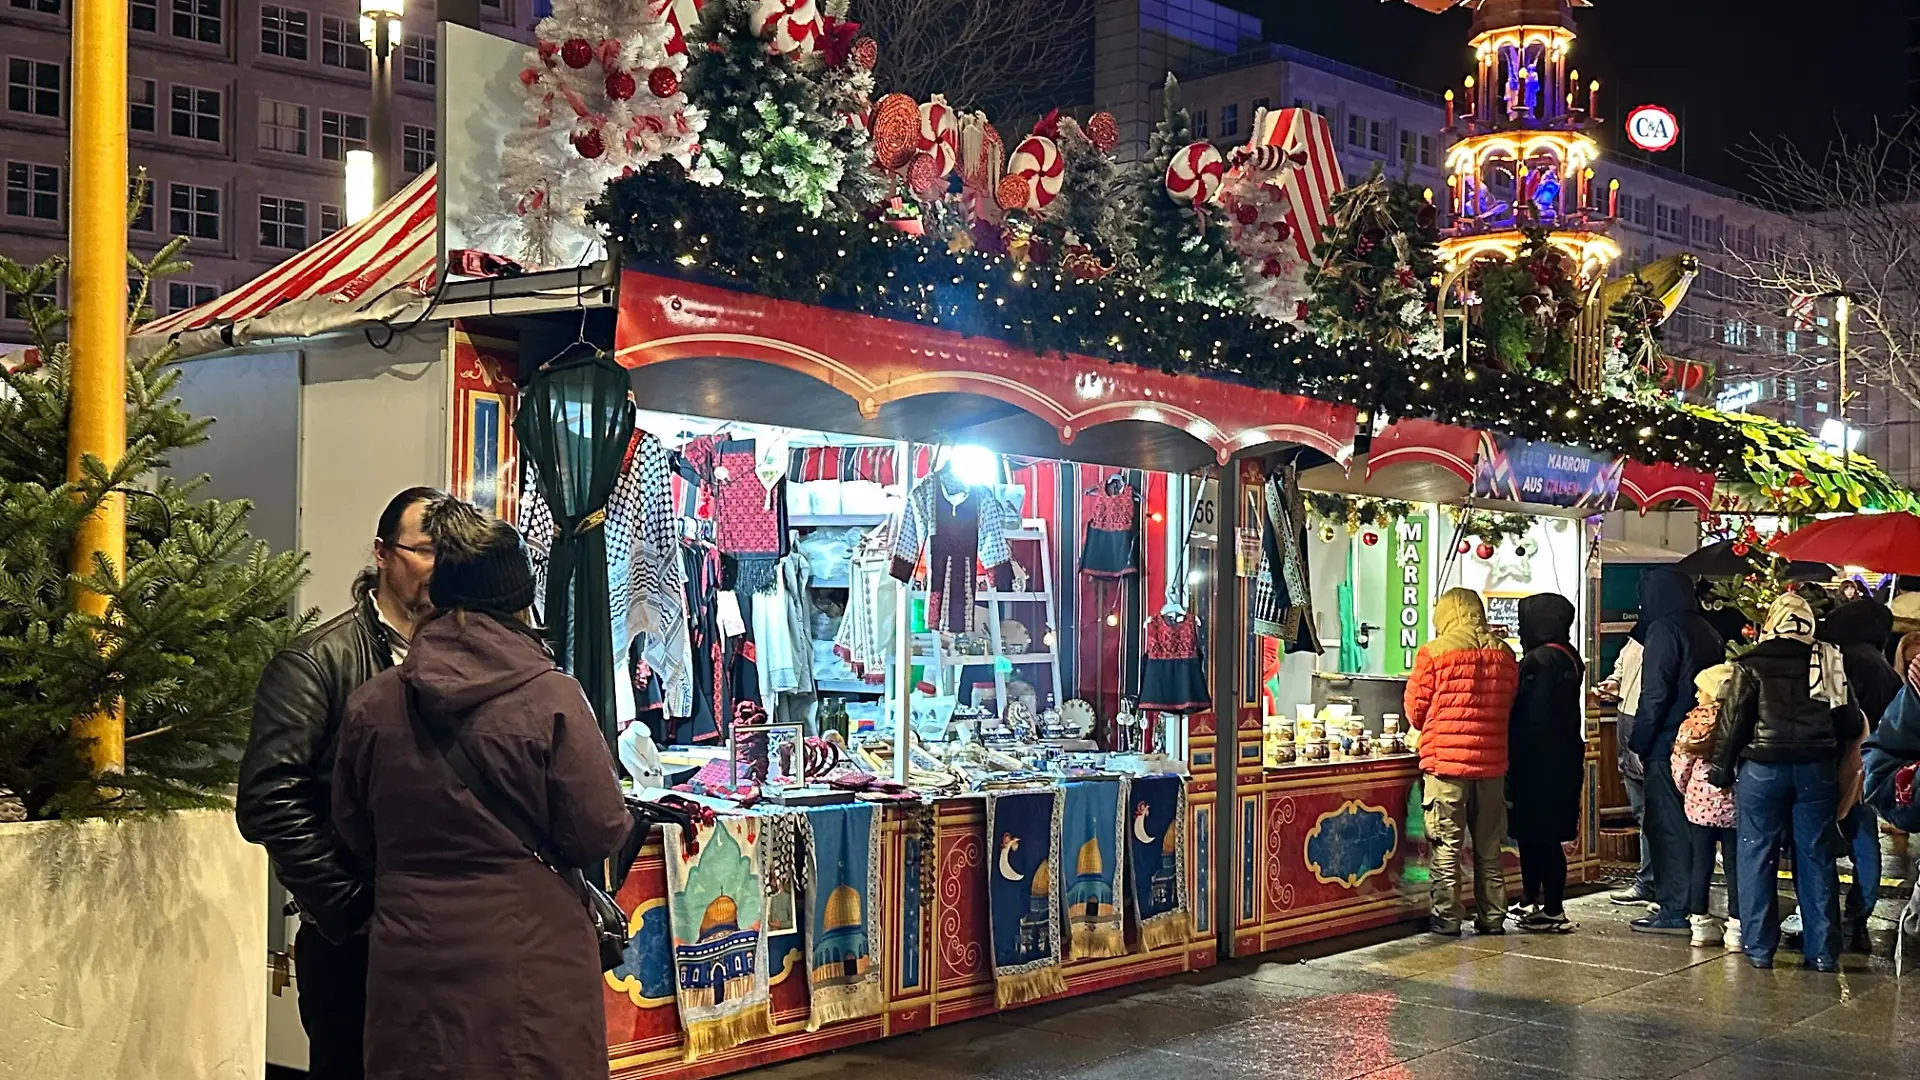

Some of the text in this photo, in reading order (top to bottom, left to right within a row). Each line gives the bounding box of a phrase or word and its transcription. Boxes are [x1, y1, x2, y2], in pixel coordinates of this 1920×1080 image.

[1636, 117, 1669, 138] C&A
[1547, 453, 1591, 473] MARRONI
[1522, 476, 1544, 493] AUS
[1400, 522, 1422, 668] MARRONI
